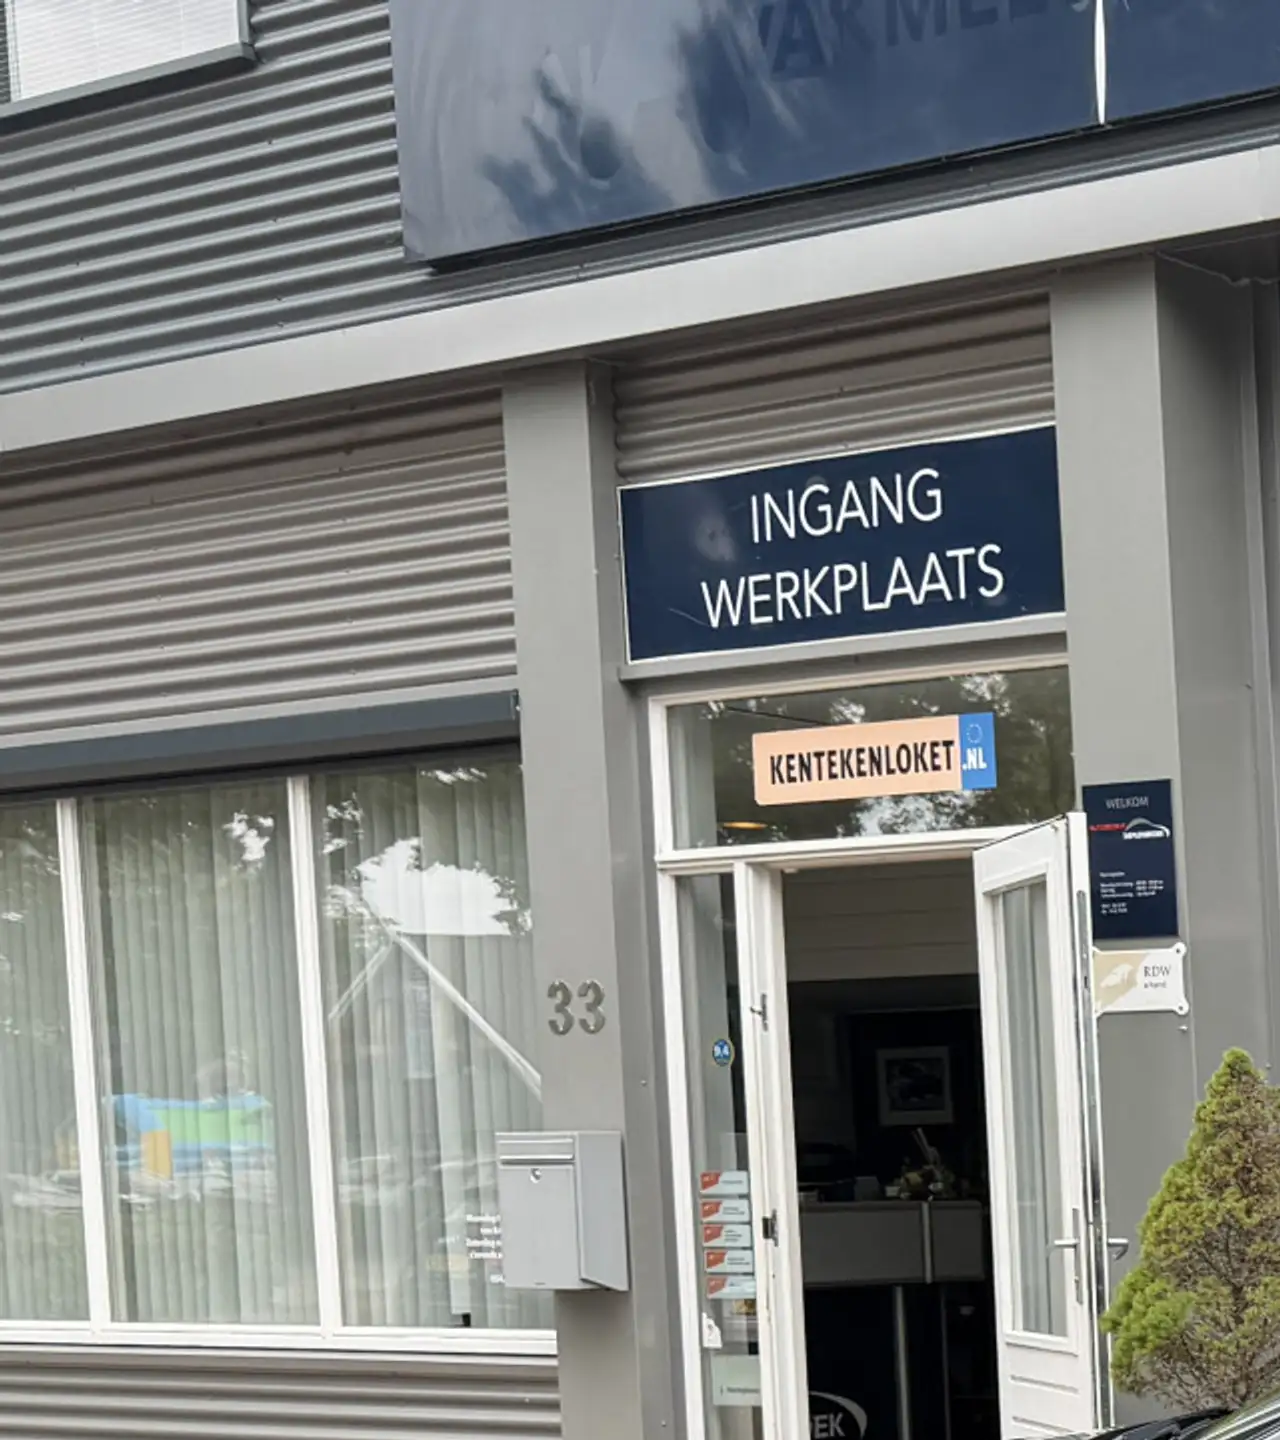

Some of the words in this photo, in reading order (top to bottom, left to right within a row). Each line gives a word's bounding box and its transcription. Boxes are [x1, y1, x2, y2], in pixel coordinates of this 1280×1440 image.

[751, 467, 943, 543] INGANG
[701, 543, 1005, 628] WERKPLAATS
[770, 740, 955, 785] KENTEKENLOKET
[1105, 796, 1149, 809] WELKOM
[1143, 964, 1172, 978] RDW
[547, 980, 606, 1035] 33
[810, 1412, 845, 1440] EK
